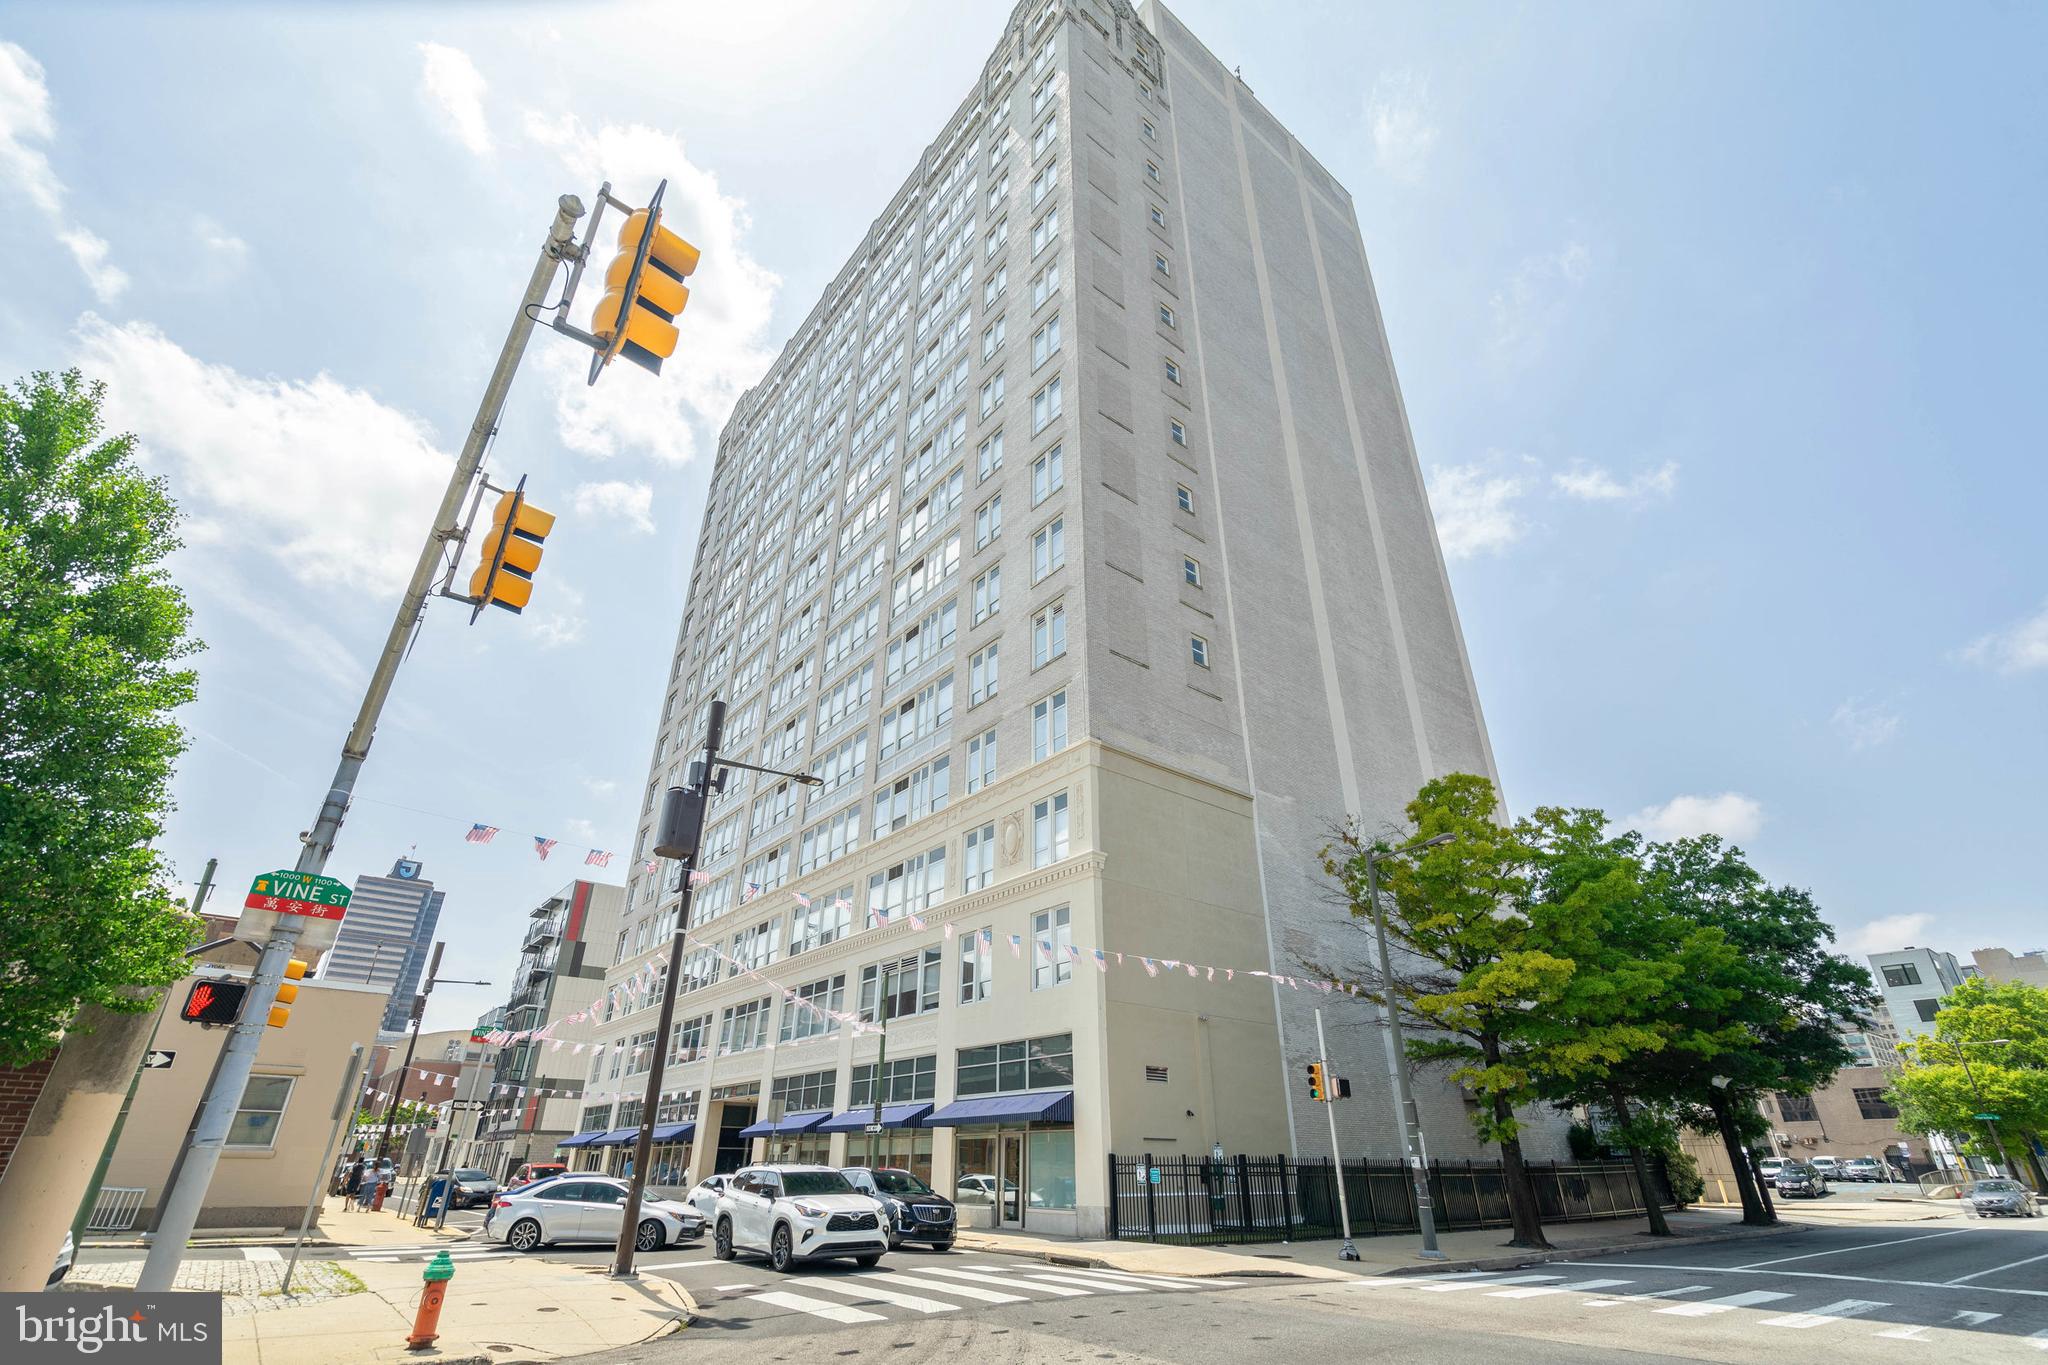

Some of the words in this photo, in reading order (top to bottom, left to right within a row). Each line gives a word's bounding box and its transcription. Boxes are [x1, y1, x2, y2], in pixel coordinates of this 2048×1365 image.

[280, 872, 301, 881] 1000
[302, 875, 313, 884] W
[315, 878, 333, 887] 1100
[273, 880, 324, 902] VINE
[329, 894, 348, 905] ST
